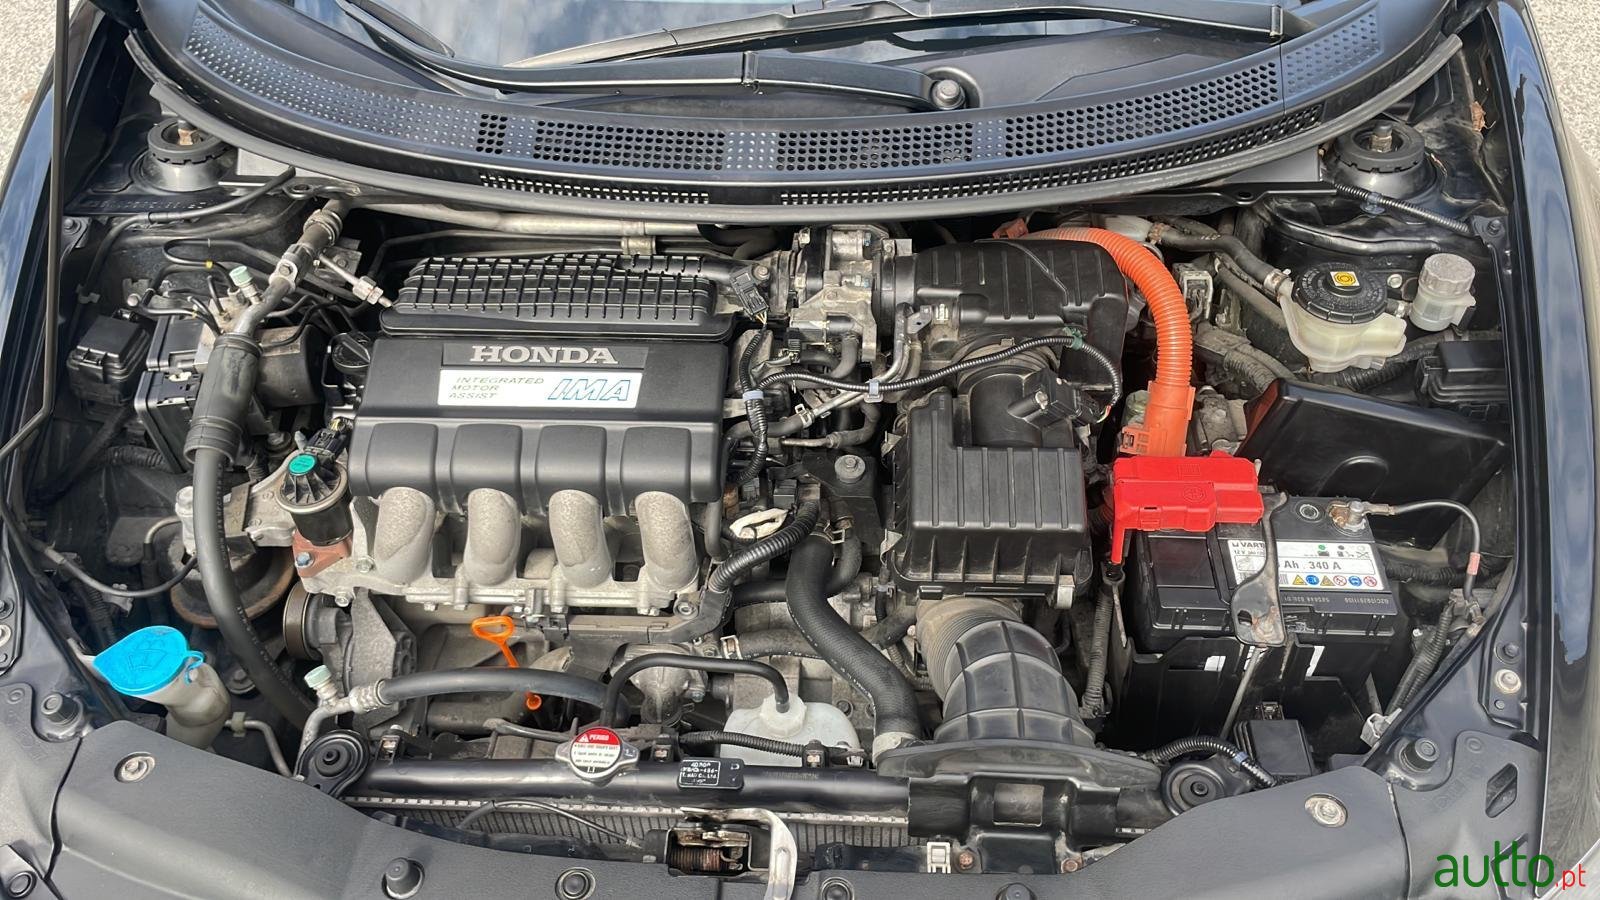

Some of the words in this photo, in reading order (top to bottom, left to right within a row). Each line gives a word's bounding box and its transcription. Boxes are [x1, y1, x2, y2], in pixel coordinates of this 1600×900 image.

[470, 345, 618, 364] HONDA
[455, 377, 544, 385] INTEGRATED
[547, 378, 631, 401] IMA
[1284, 560, 1299, 569] Ah
[1309, 561, 1329, 570] 340
[1333, 561, 1342, 570] A
